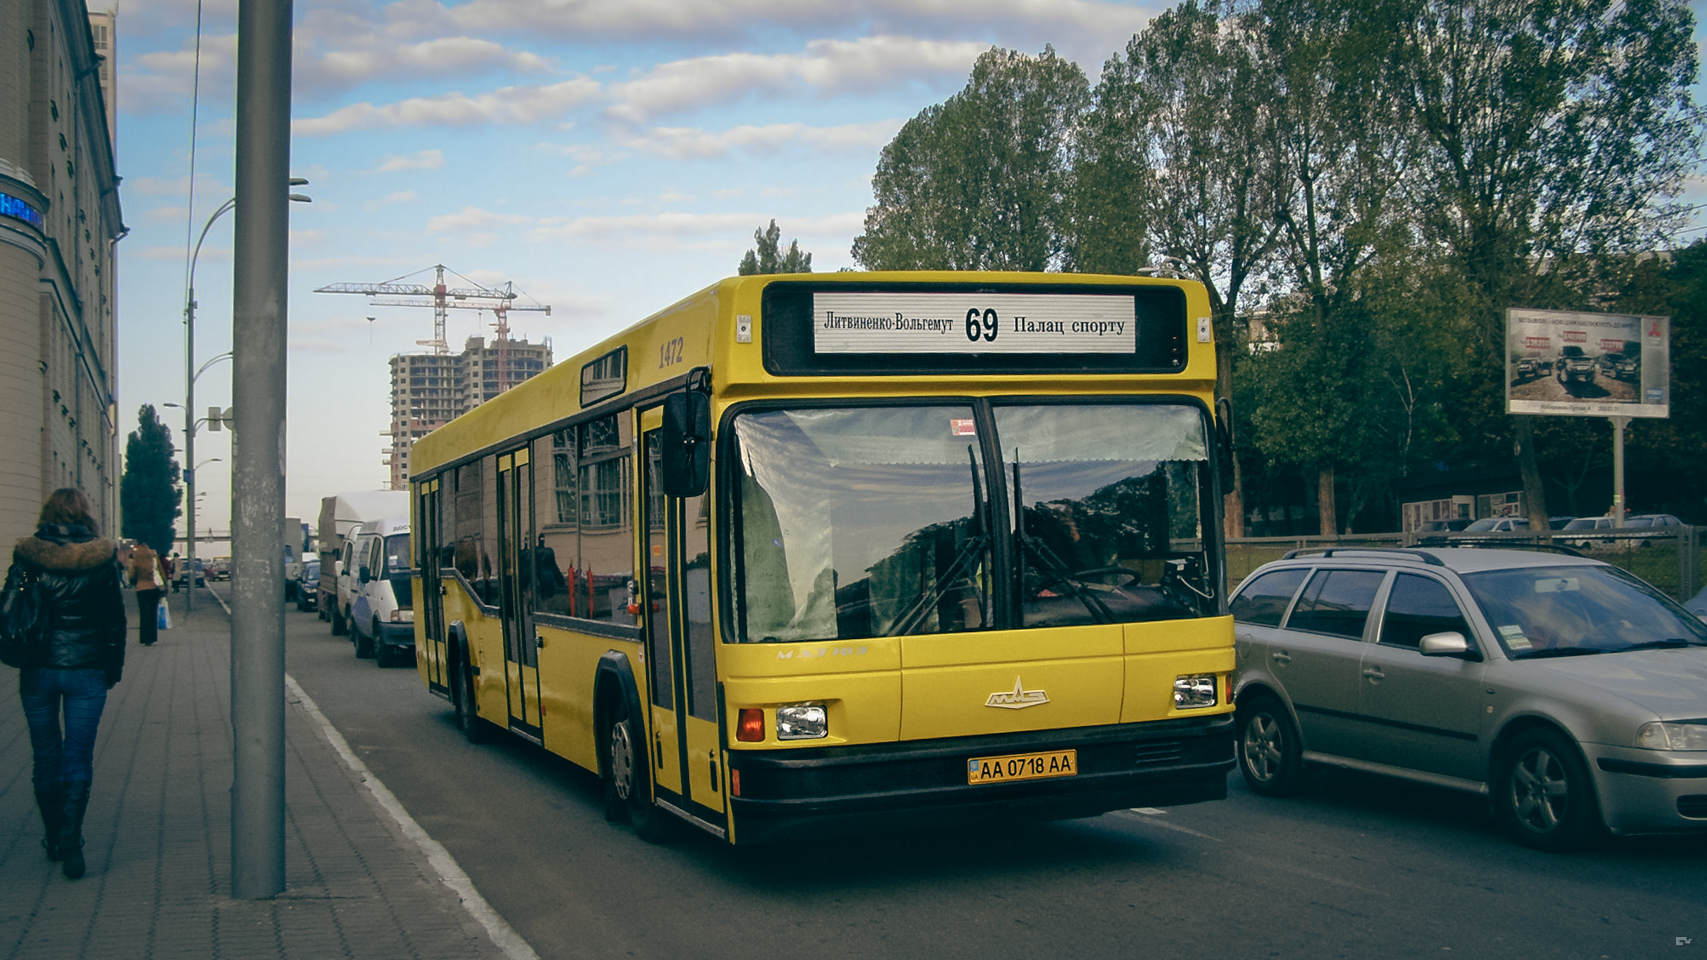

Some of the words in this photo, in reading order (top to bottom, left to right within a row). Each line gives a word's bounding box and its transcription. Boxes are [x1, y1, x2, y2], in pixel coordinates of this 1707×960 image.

[824, 311, 954, 335] Литвиненко-Вольгемут
[965, 308, 998, 342] 69
[1013, 316, 1065, 335] Палац
[1071, 321, 1125, 336] спорту
[659, 336, 684, 369] 1472
[981, 761, 1003, 779] AA
[1008, 757, 1045, 776] 0718
[1049, 755, 1071, 773] AA
